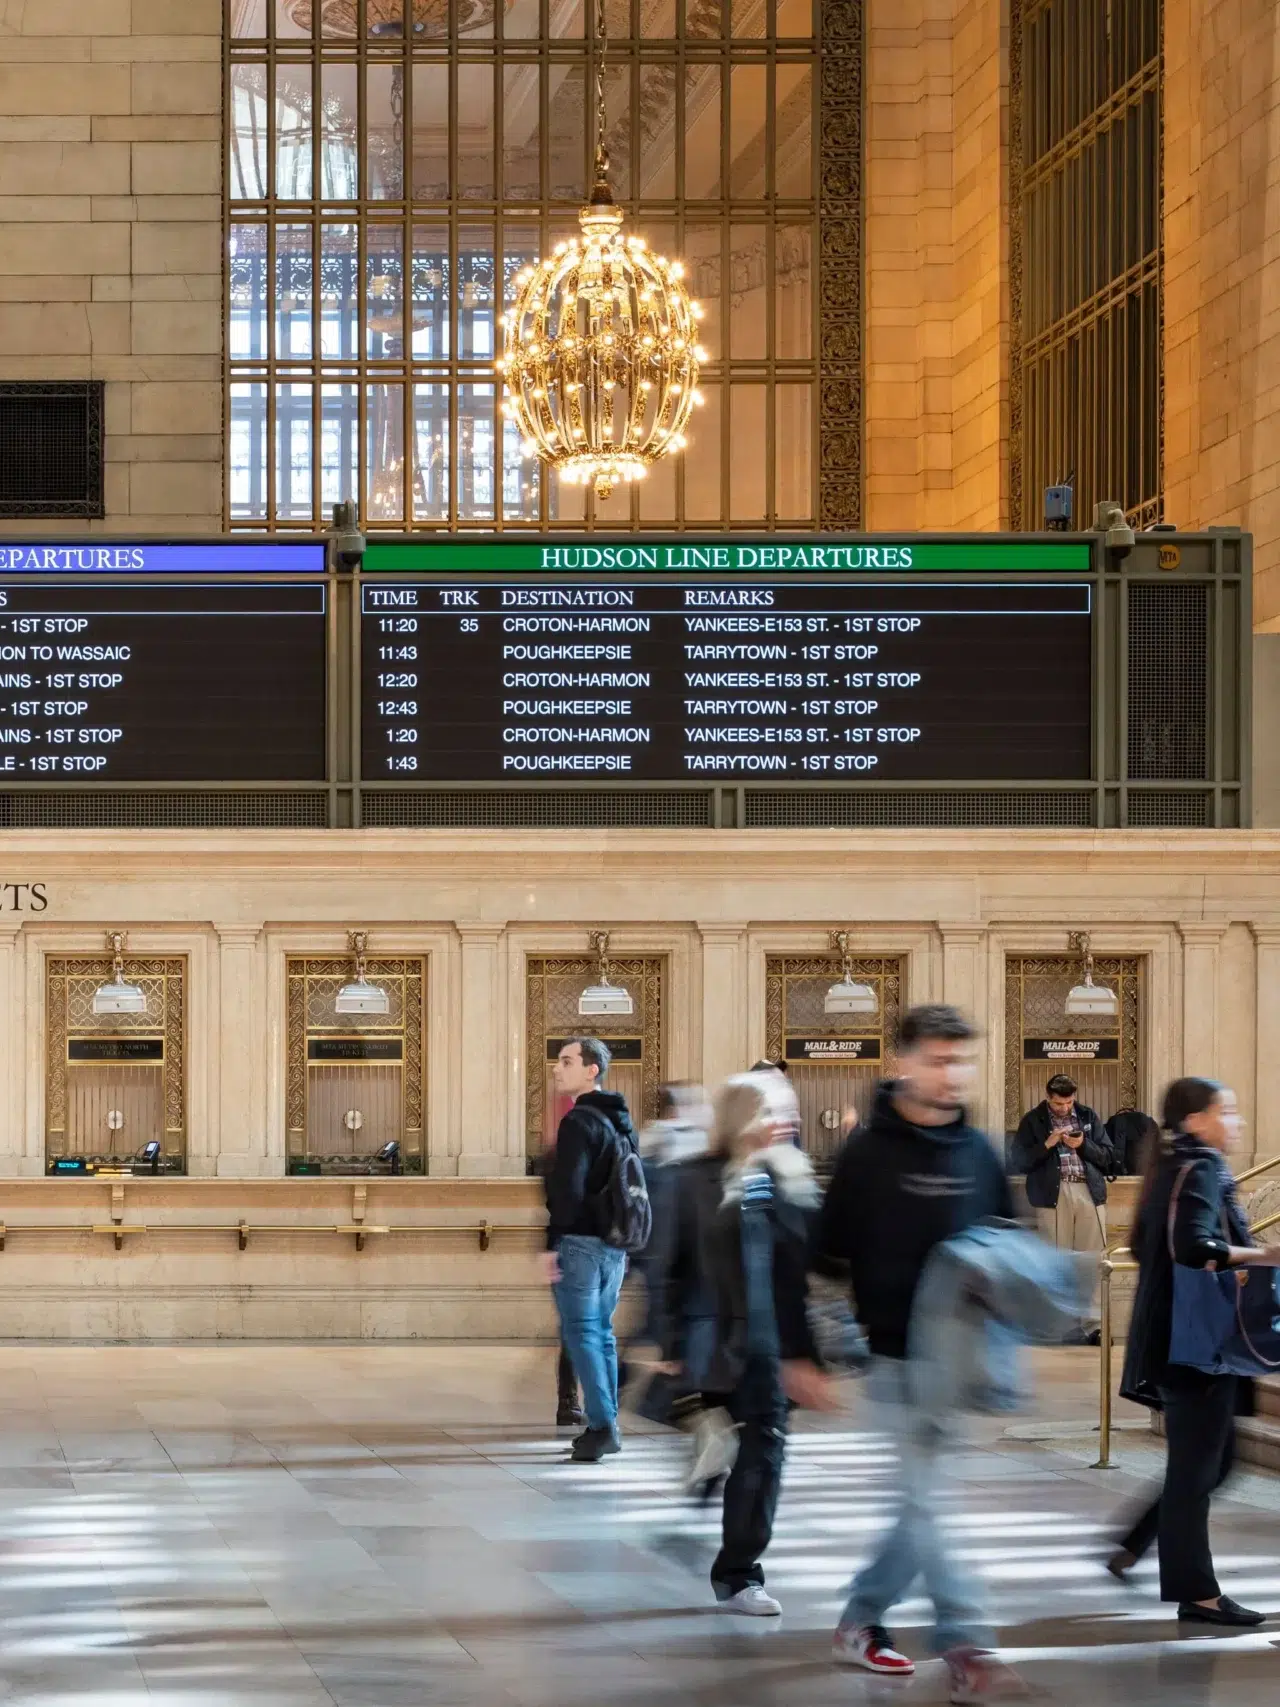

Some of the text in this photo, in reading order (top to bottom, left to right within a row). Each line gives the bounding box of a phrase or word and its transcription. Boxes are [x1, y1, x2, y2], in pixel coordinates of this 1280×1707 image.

[541, 548, 912, 567] HUDSON LINE DEPARTURES
[370, 590, 774, 605] TIME TRK DESTINATION REMARKS
[12, 619, 40, 633] 1ST
[44, 619, 88, 633] STOP
[379, 618, 921, 632] 11:20 35 CROTON-HARMON YANKEES-E153 ST. 1ST STOP
[30, 646, 52, 660] TO
[57, 646, 130, 660] WASSAIC
[379, 645, 878, 659] 11:43 POUGHKEEPSIE TARRYTOWN 1ST STOP
[46, 674, 75, 688] 1ST
[79, 674, 122, 688] STOP
[378, 673, 921, 687] 12:20 CROTON-HARMON YANKEES-E153 ST. 1ST STOP
[11, 702, 40, 715] 1ST
[44, 701, 88, 715] STOP
[378, 701, 878, 714] 12:43 POUGHKEEPSIE TARRYTOWN 1ST STOP
[46, 729, 75, 743] 1ST
[79, 729, 122, 743] STOP
[387, 728, 920, 742] 1:20 CROTON-HARMON YANKEES-E153 ST. 1ST STOP
[30, 757, 59, 770] 1ST
[63, 757, 106, 770] STOP
[387, 756, 878, 770] 1:43 POUGHKEEPSIE TARRYTOWN 1ST STOP
